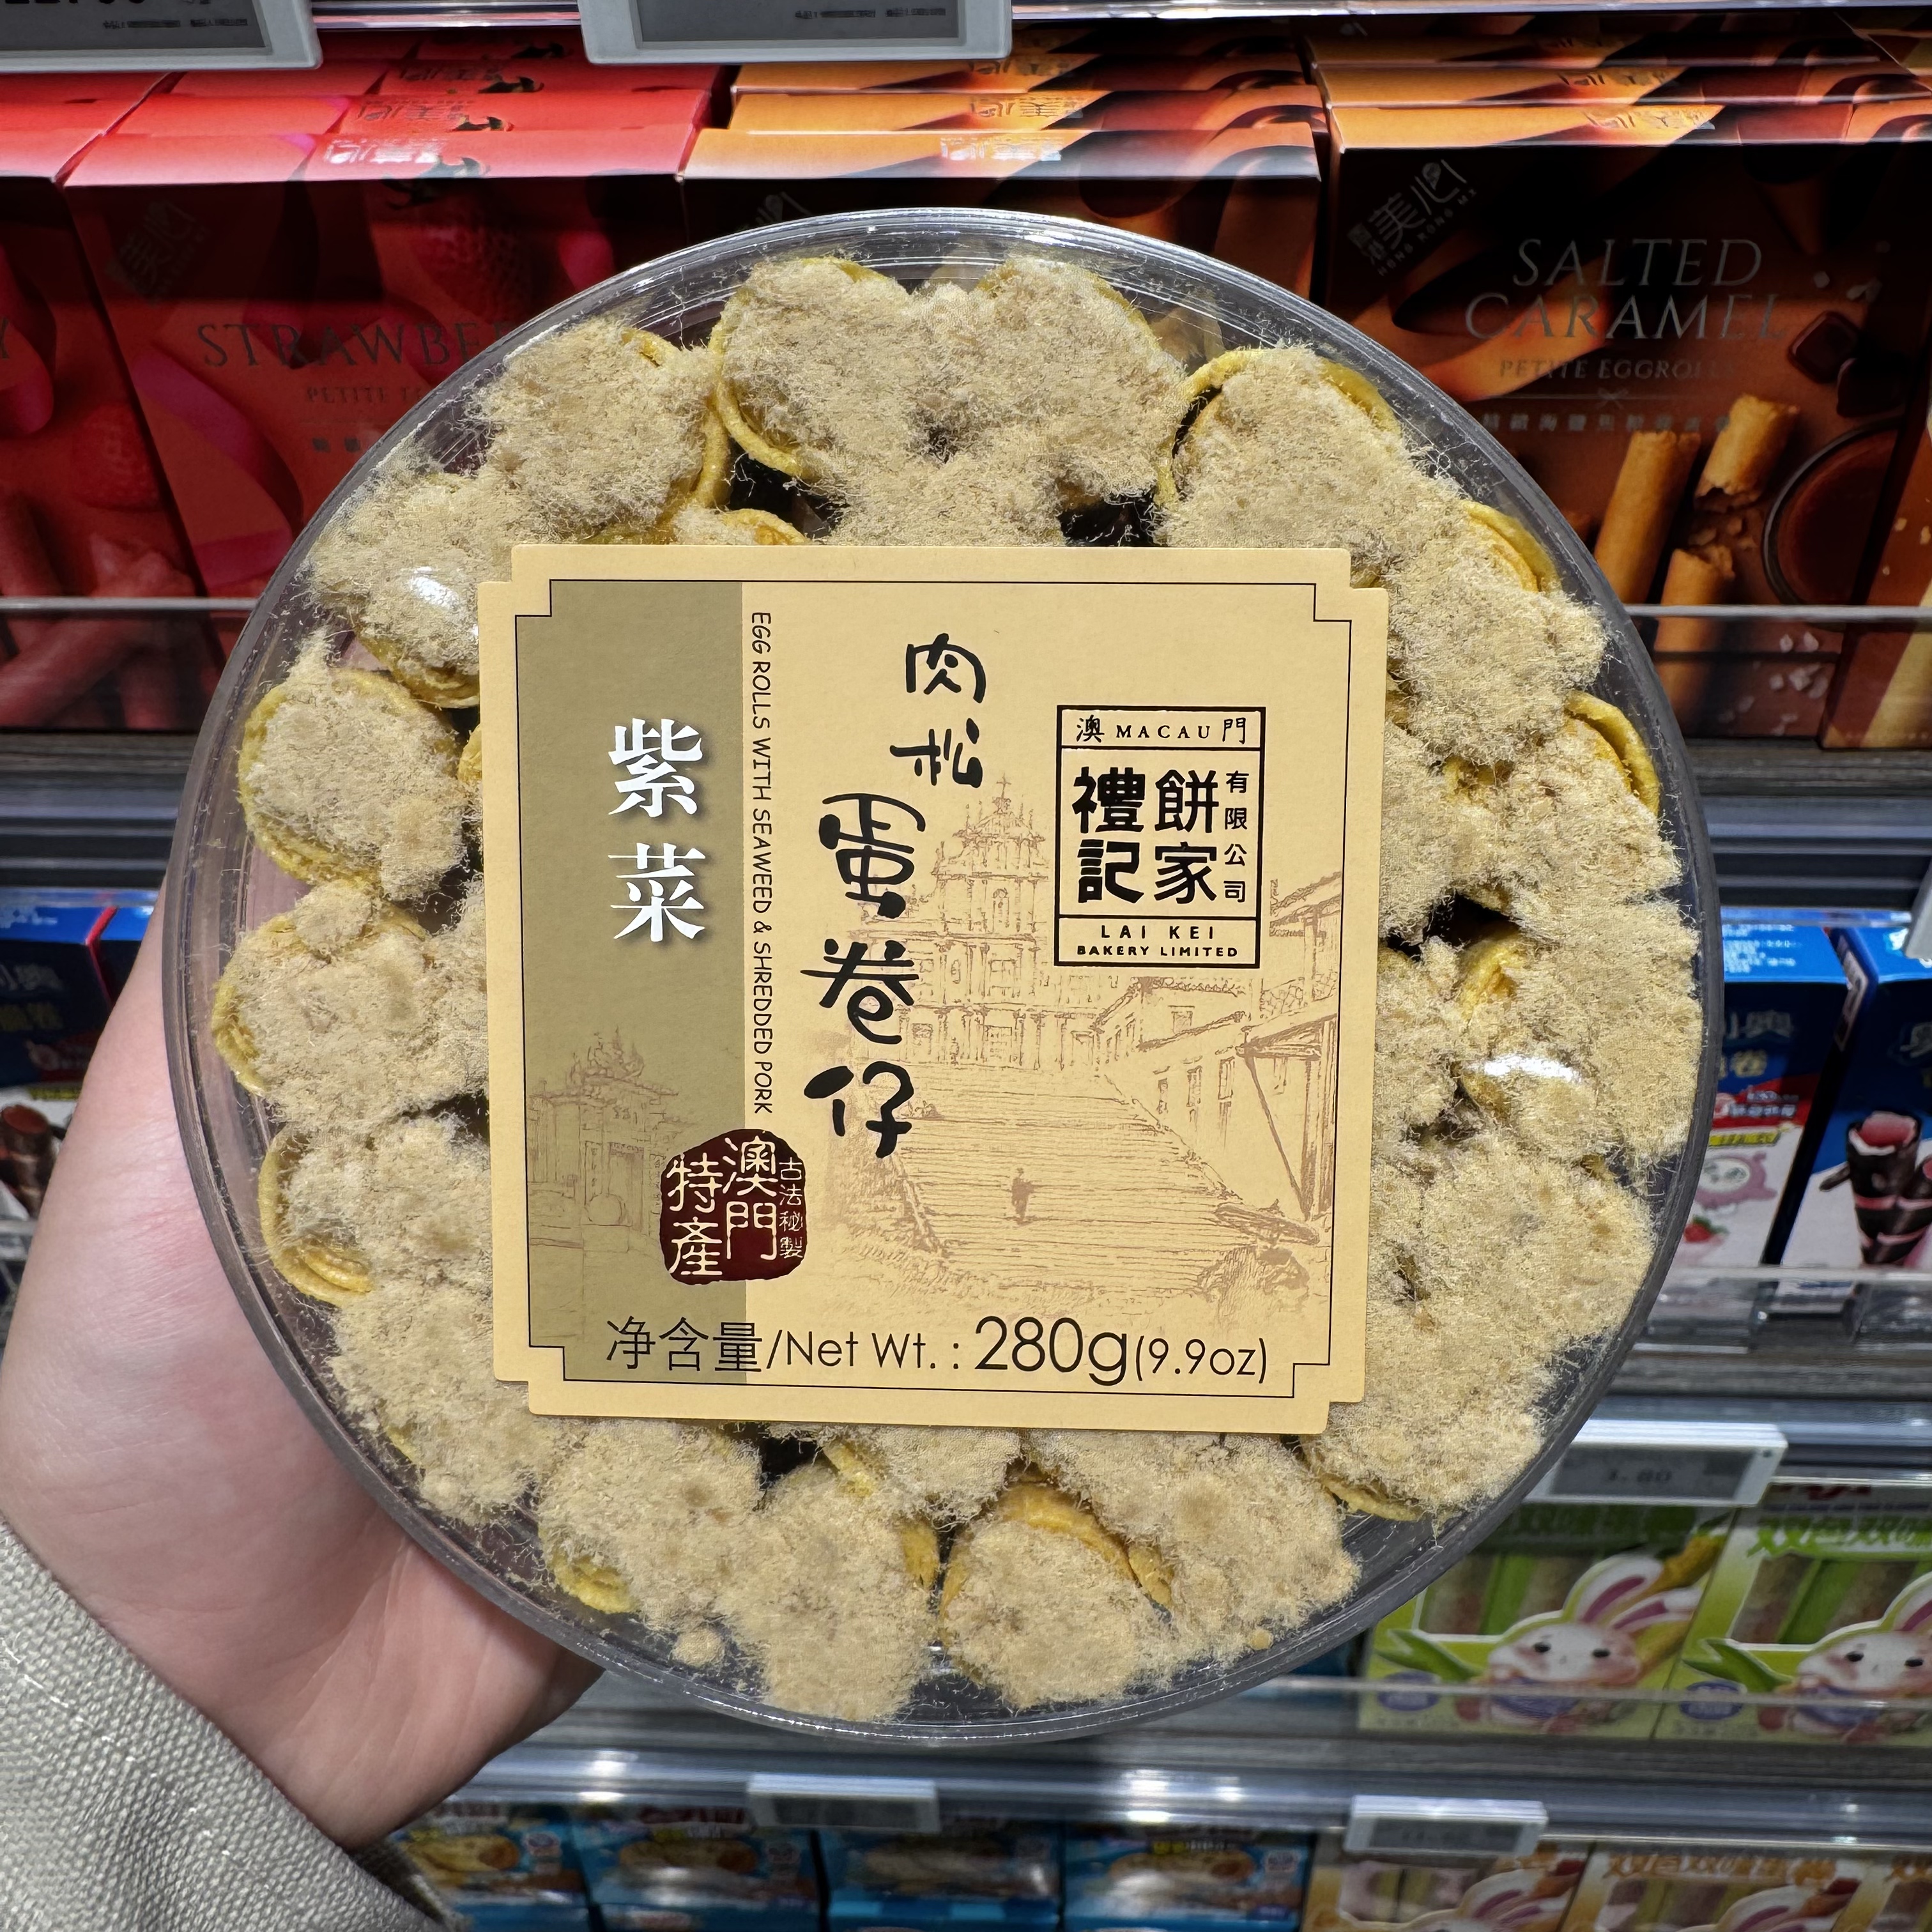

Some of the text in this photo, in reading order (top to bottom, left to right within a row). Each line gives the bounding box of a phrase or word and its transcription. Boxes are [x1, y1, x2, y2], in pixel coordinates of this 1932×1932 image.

[1512, 237, 1763, 287] SALTED
[1464, 290, 1788, 340] CARAMEL
[1075, 714, 1247, 745] 澳 MACAU 門
[608, 717, 706, 942] 紫菜
[1223, 770, 1250, 903] 有限公司
[751, 611, 774, 1115] EGG ROLLS WITH SEAWEED & SHREDDED PORK
[1077, 945, 1239, 958] BAKERY LIMITED
[1101, 924, 1214, 940] LAI KEI
[974, 1315, 1267, 1386] 280g(9.9oz)
